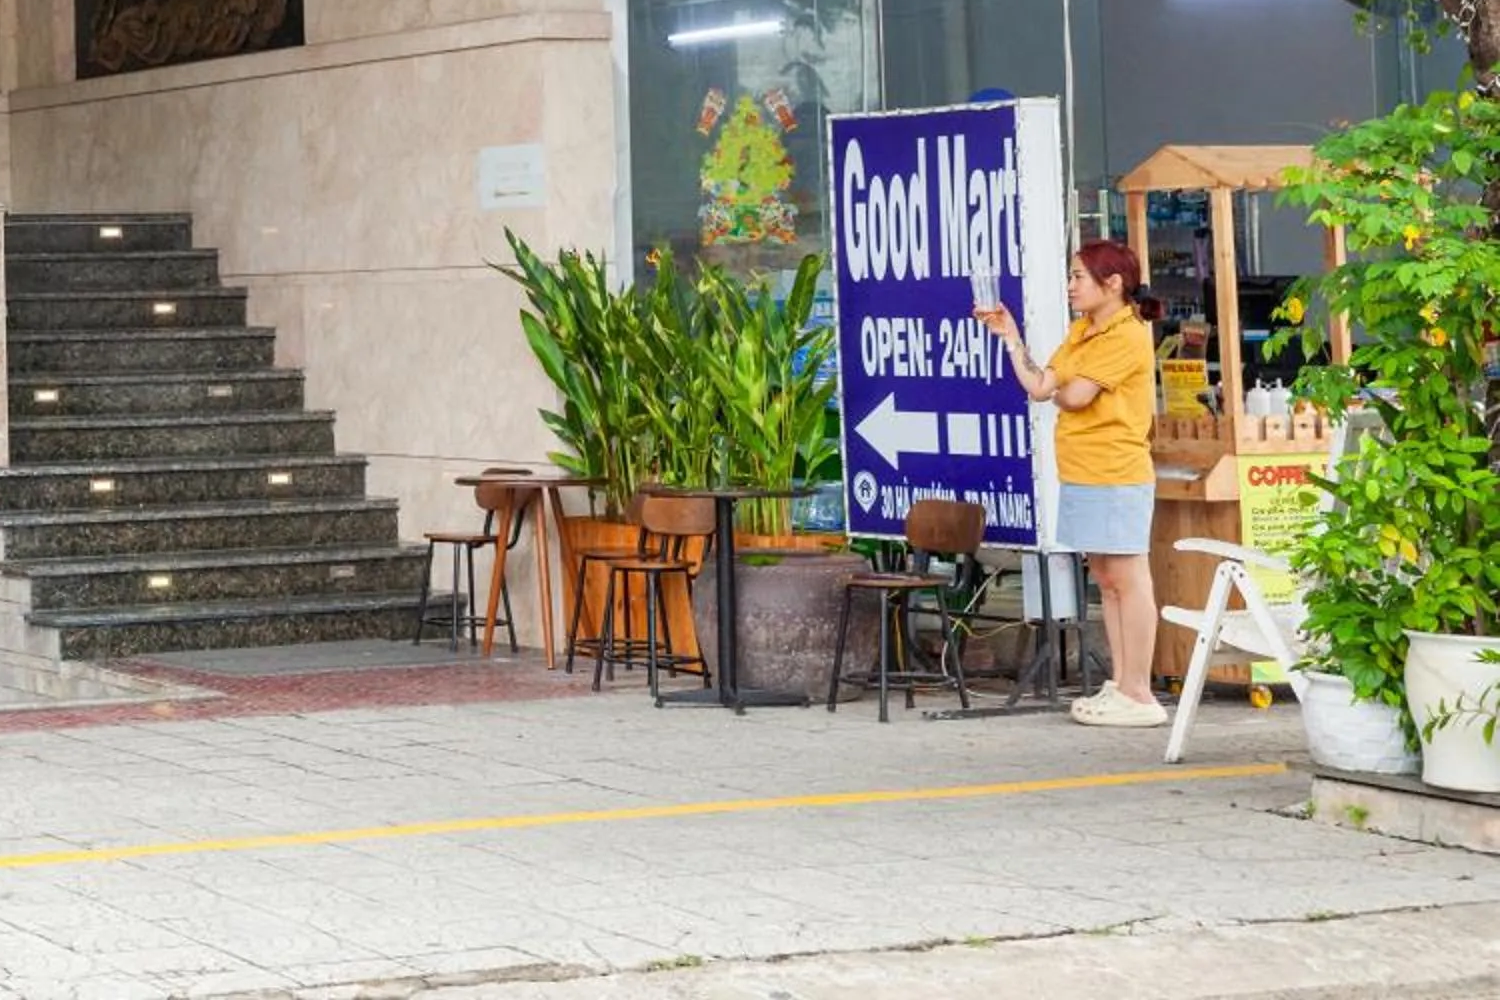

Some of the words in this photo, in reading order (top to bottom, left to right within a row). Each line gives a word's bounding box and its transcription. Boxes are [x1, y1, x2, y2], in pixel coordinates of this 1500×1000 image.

[843, 136, 930, 282] Good
[937, 134, 1020, 278] Mart
[861, 315, 933, 377] OPEN:
[881, 485, 894, 519] 30
